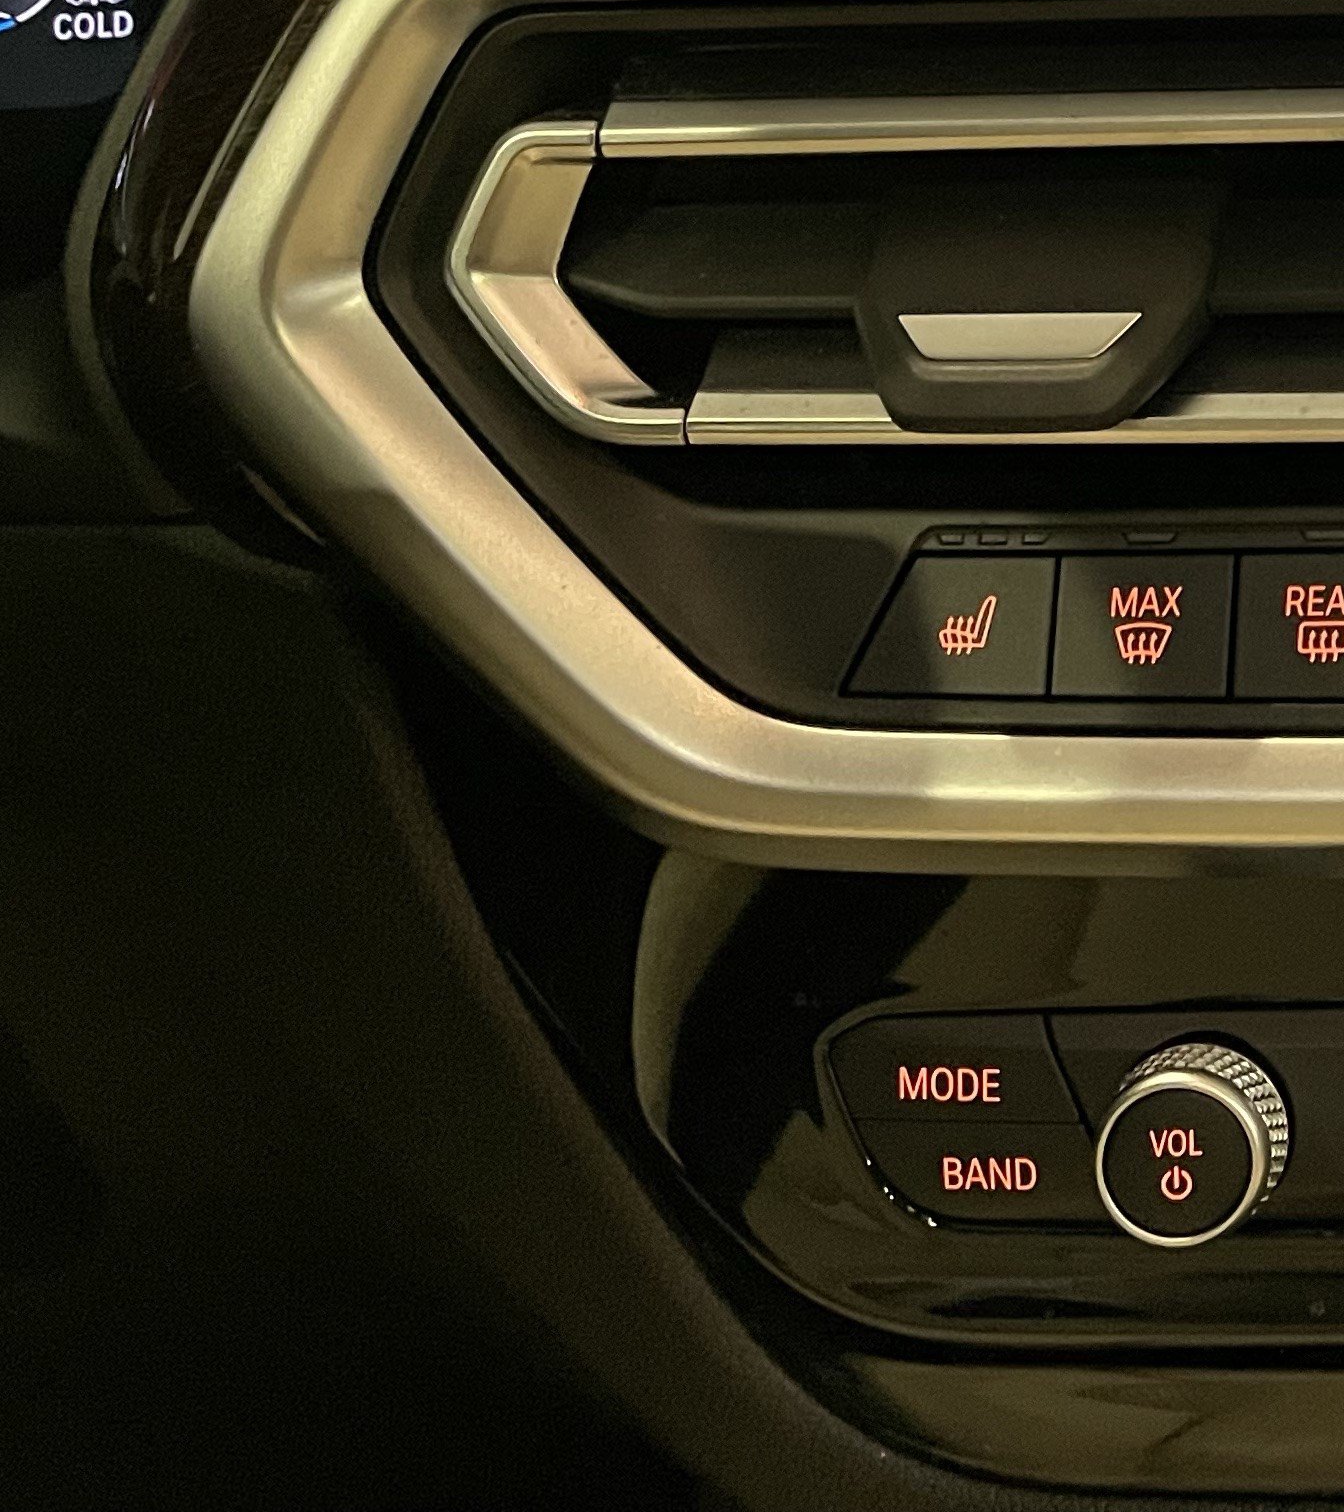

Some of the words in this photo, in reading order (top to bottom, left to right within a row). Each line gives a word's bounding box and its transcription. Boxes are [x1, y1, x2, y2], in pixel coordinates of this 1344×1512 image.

[52, 8, 134, 42] COLD
[1109, 585, 1184, 619] MAX
[898, 1066, 1002, 1103] MODE
[1149, 1128, 1204, 1159] VOL
[941, 1156, 1038, 1192] BAND
